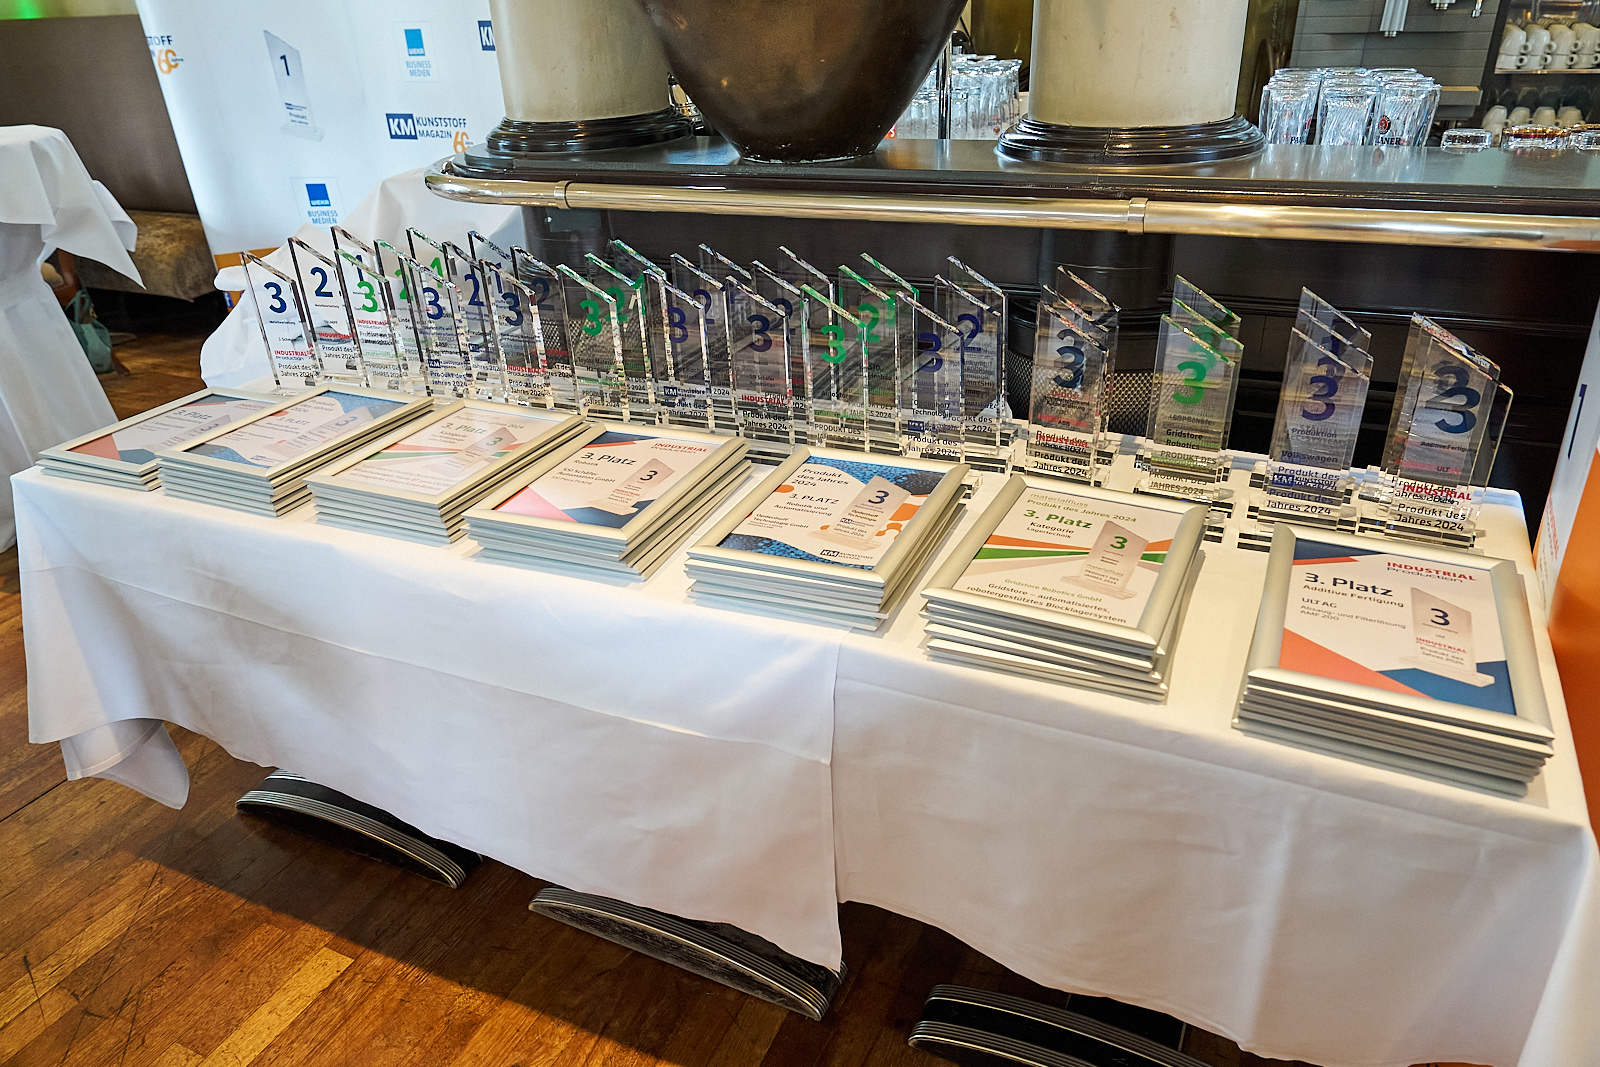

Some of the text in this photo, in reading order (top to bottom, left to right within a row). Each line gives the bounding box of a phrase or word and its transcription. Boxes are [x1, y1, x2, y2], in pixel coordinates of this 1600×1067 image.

[280, 55, 290, 76] 1
[406, 60, 431, 68] BUSINESS
[409, 69, 430, 77] MEDIEN
[389, 118, 415, 136] KM
[415, 117, 467, 128] KUNSTSTOFF
[418, 130, 452, 138] MAGAZIN
[430, 257, 443, 288] 1
[310, 267, 333, 297] 2
[357, 281, 378, 312] 3
[464, 274, 484, 306] 2
[531, 277, 554, 311] 2
[264, 282, 287, 313] 3
[423, 287, 443, 320] 3
[502, 292, 524, 326] 3
[605, 286, 628, 326] 2
[693, 289, 715, 325] 2
[580, 300, 602, 336] 3
[770, 298, 796, 337] 2
[856, 303, 880, 343] 2
[747, 314, 772, 352] 3
[954, 313, 982, 352] 2
[820, 324, 846, 364] 3
[1053, 346, 1085, 388] 3
[1172, 361, 1206, 405] 3
[714, 388, 730, 396] 2024
[1302, 375, 1338, 421] 3
[742, 395, 785, 405] INDUSTRIAL
[743, 411, 771, 420] Produkt
[1434, 387, 1480, 434] 3
[334, 416, 358, 426] 3
[744, 419, 787, 430] Jahres 2024
[978, 416, 993, 424] des
[455, 424, 488, 434] Platz
[972, 425, 993, 433] 2024
[1166, 429, 1203, 440] Gridstore
[1292, 427, 1337, 438] Produktion
[486, 437, 503, 446] 3
[654, 443, 707, 452] INDUSTRIAL
[942, 438, 958, 446] des
[1036, 434, 1090, 448] INDUSTRIAL
[1166, 439, 1200, 450] Robotics
[581, 452, 637, 465] 3. Platz
[1034, 451, 1069, 463] Produkt
[1161, 451, 1199, 460] PRODUKT
[1281, 450, 1338, 463] Volkswagen
[640, 470, 658, 481] 3
[803, 468, 842, 478] Produkt
[1065, 466, 1087, 476] 2024
[1278, 466, 1340, 480] Produkt des
[817, 477, 849, 485] Jahres
[1149, 481, 1204, 494] JAHRES 2024
[868, 490, 889, 504] 3
[1269, 489, 1334, 504] Produkt des
[1402, 484, 1472, 500] INDUSTRIAL
[801, 495, 840, 504] PLATZ
[1030, 494, 1089, 507] materialfluss
[774, 505, 832, 516] Automatisierung
[1027, 499, 1062, 509] Produkt
[1080, 510, 1110, 518] Jahres
[1112, 514, 1137, 522] 2024
[1267, 500, 1331, 514] Jahres 2024
[1398, 503, 1466, 520] Produkt des
[1023, 509, 1093, 529] 3. Platz
[1395, 514, 1464, 531] Jahres 2024
[1026, 527, 1072, 539] Lagertechnik
[1030, 522, 1074, 534] Kategorie
[1110, 536, 1128, 549] 3
[1387, 562, 1476, 581] INDUSTRIAL
[1387, 567, 1463, 583] Production
[1004, 578, 1103, 602] Gridstore Robotics GmbH
[1305, 572, 1393, 597] 3. Platz
[988, 583, 1111, 614] Gridstore automatisiertes,
[1301, 597, 1321, 605] ULT
[1303, 584, 1404, 608] Additive Fertigung
[966, 585, 1127, 624] robotergestütztes Blocklagersystem
[1431, 608, 1450, 626] 3
[1416, 637, 1467, 654] INDUSTRIAL
